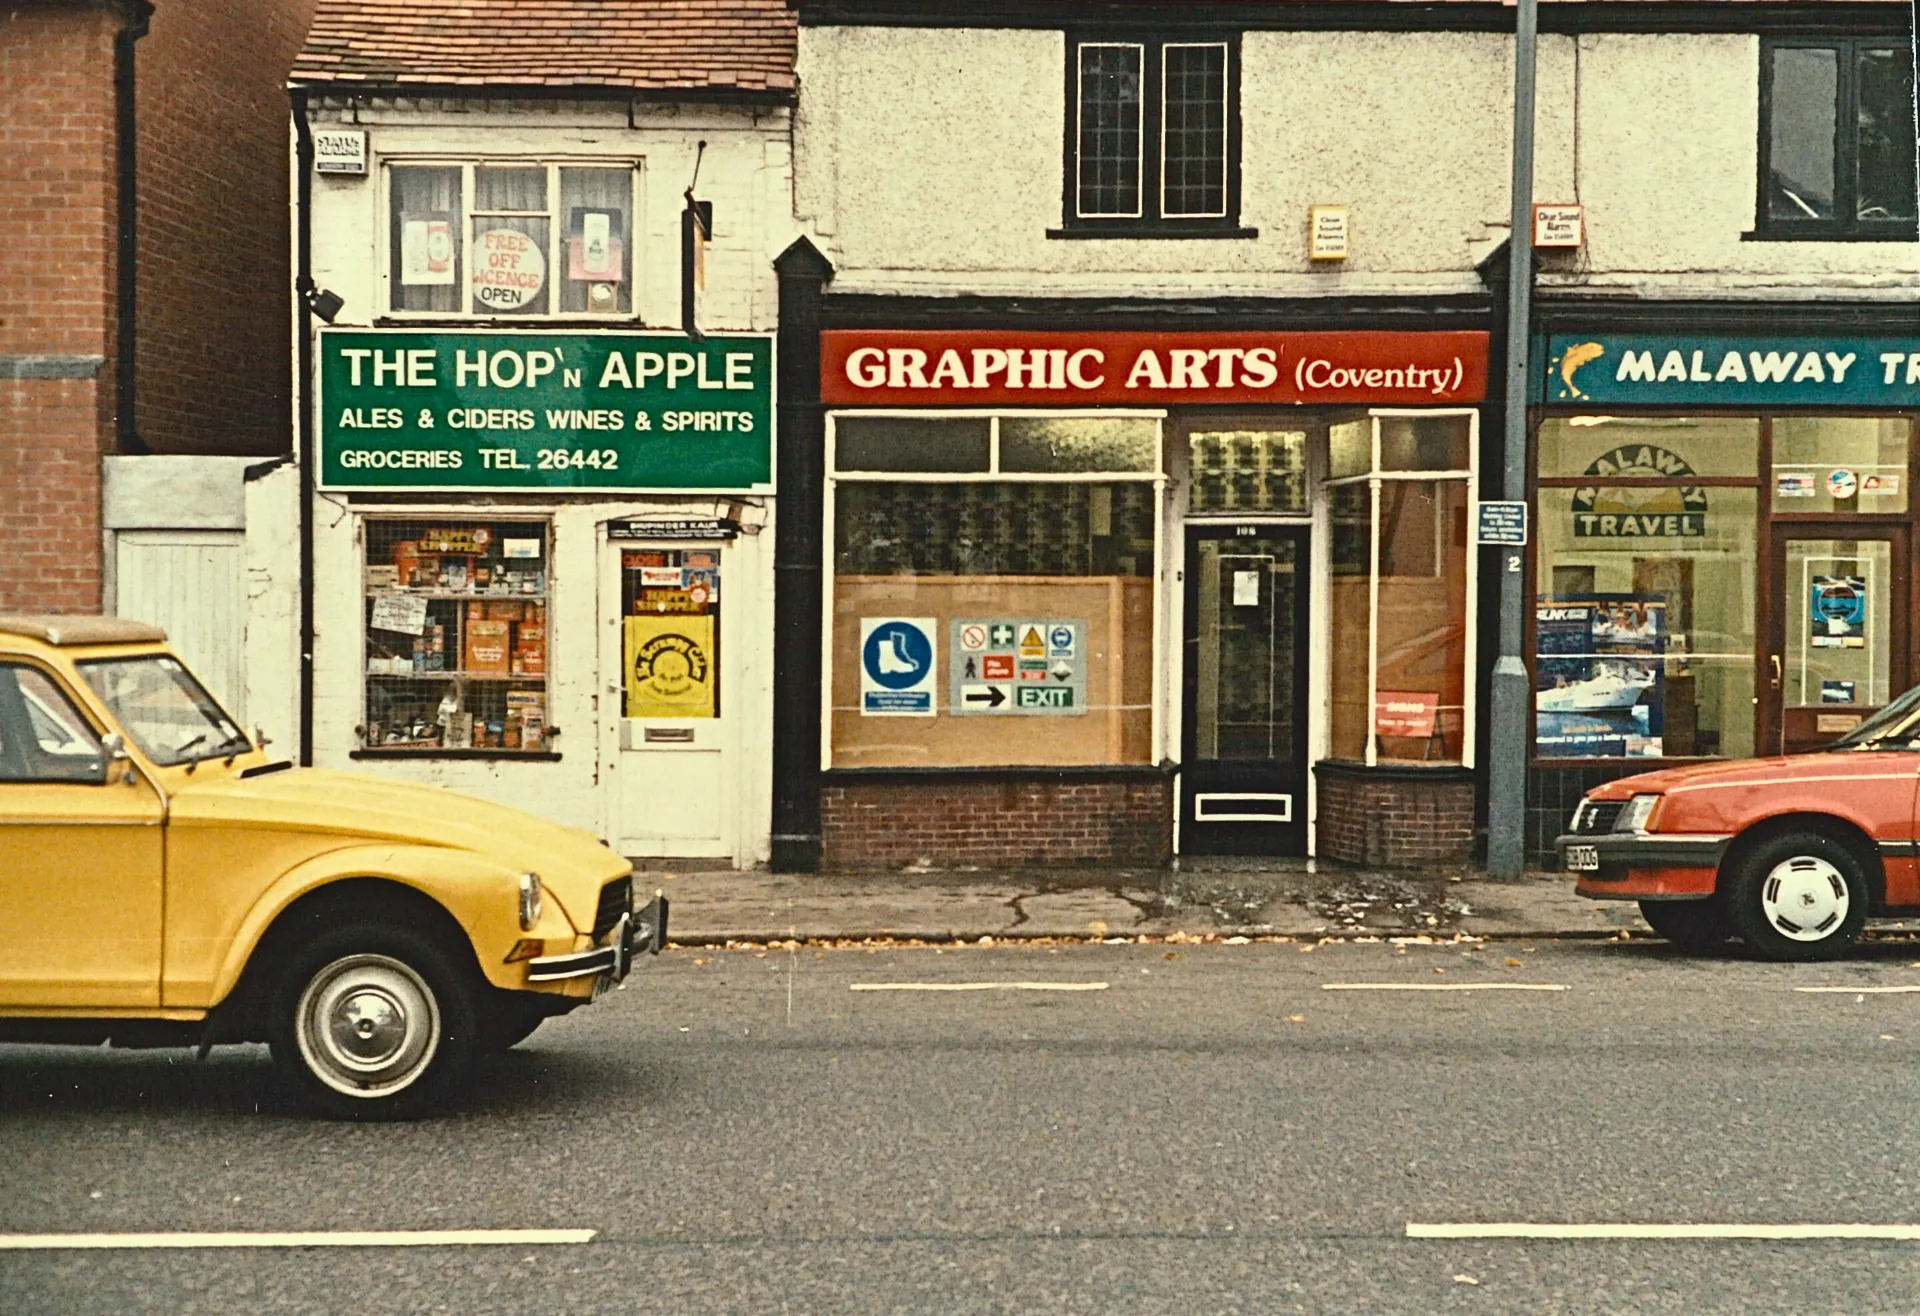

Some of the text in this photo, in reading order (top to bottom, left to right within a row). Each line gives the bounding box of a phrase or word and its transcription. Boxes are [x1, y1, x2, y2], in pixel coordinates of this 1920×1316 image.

[484, 232, 529, 253] FREE
[488, 253, 521, 269] OFF
[481, 286, 522, 303] OPEN
[340, 348, 437, 387] THE
[599, 351, 754, 391] APPLE
[845, 347, 1464, 395] GRAPHIC ARTS (Coventry)
[1615, 349, 1857, 384] MALAWAY
[339, 408, 754, 433] ALES & CIDERS WINES & SPIRITS
[339, 449, 619, 471] GROCERIES TEL. 26442
[1579, 514, 1698, 536] TRAVEL
[1508, 556, 1521, 572] 2
[1021, 688, 1068, 706] EXIT
